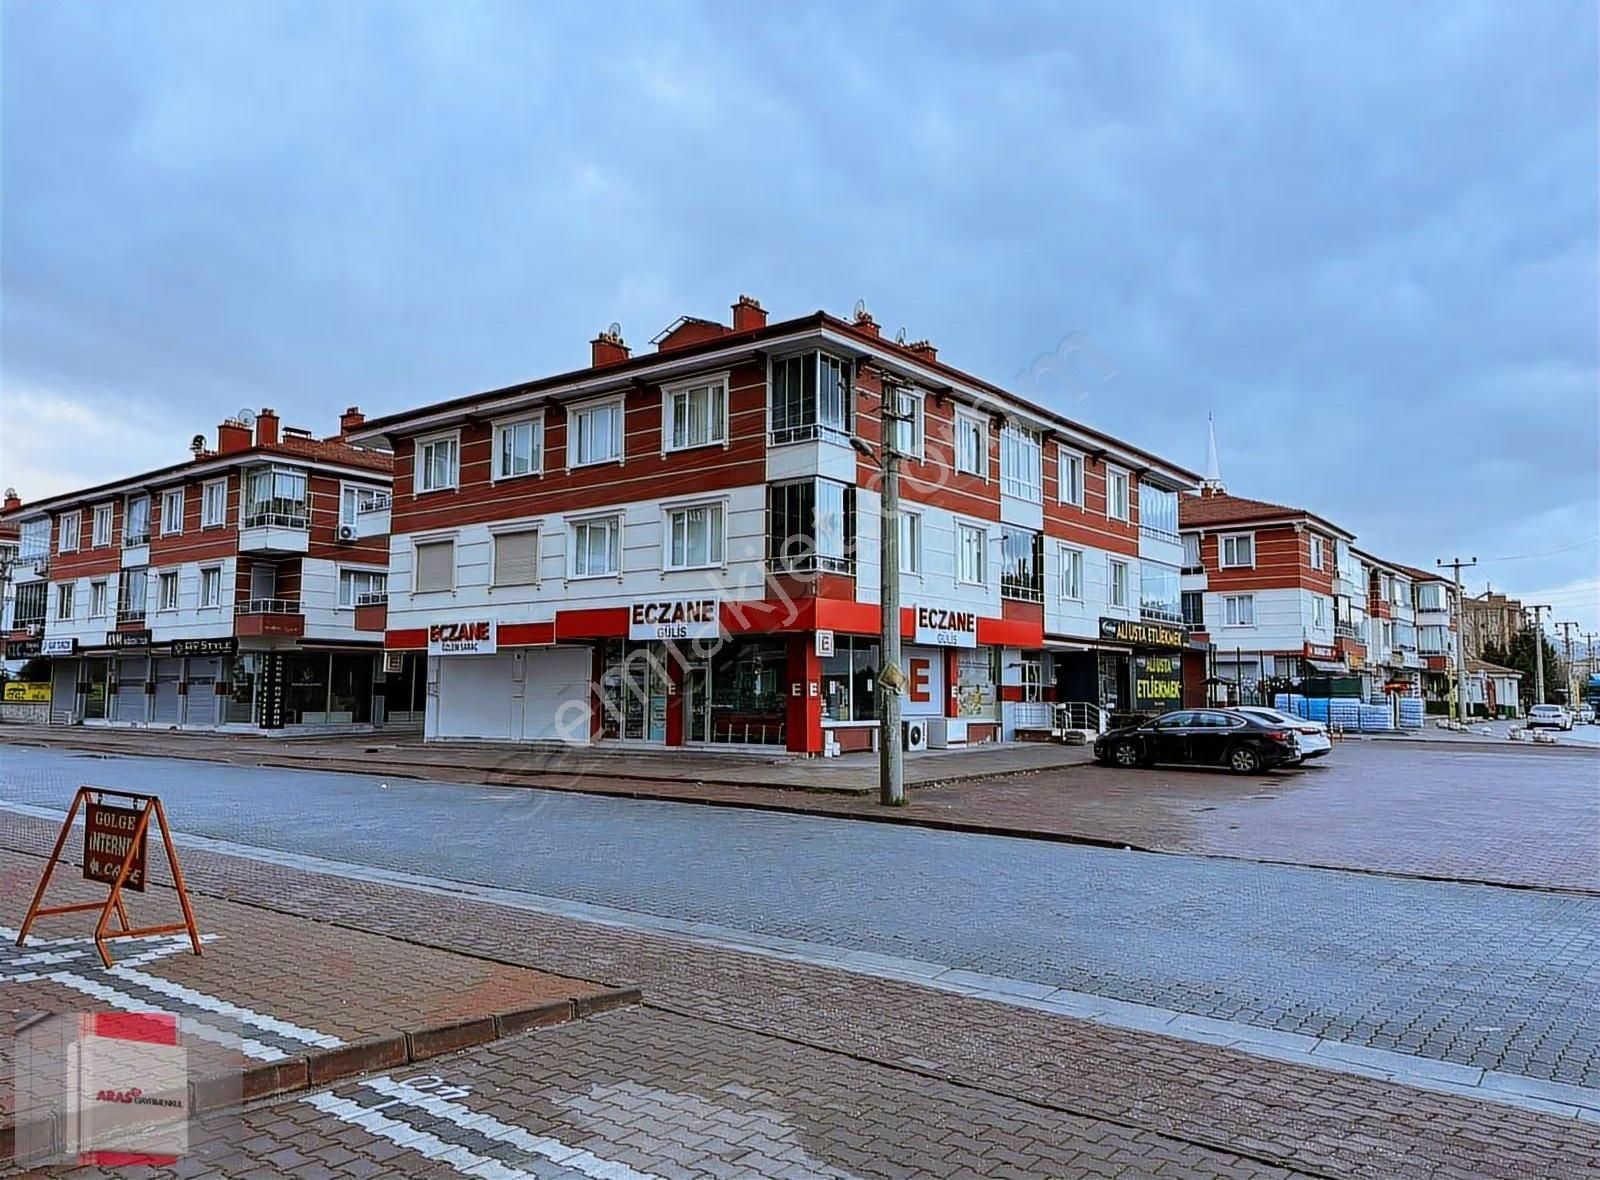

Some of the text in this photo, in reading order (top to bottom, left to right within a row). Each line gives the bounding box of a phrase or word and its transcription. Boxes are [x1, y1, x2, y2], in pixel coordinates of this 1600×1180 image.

[631, 600, 715, 625] ECZANE
[918, 607, 975, 632] ECZANE
[430, 621, 490, 642] ECZANE
[821, 637, 831, 651] E
[668, 683, 677, 696] E
[792, 683, 801, 696] E
[809, 682, 818, 697] E
[908, 658, 931, 702] E
[104, 862, 142, 885] CAE
